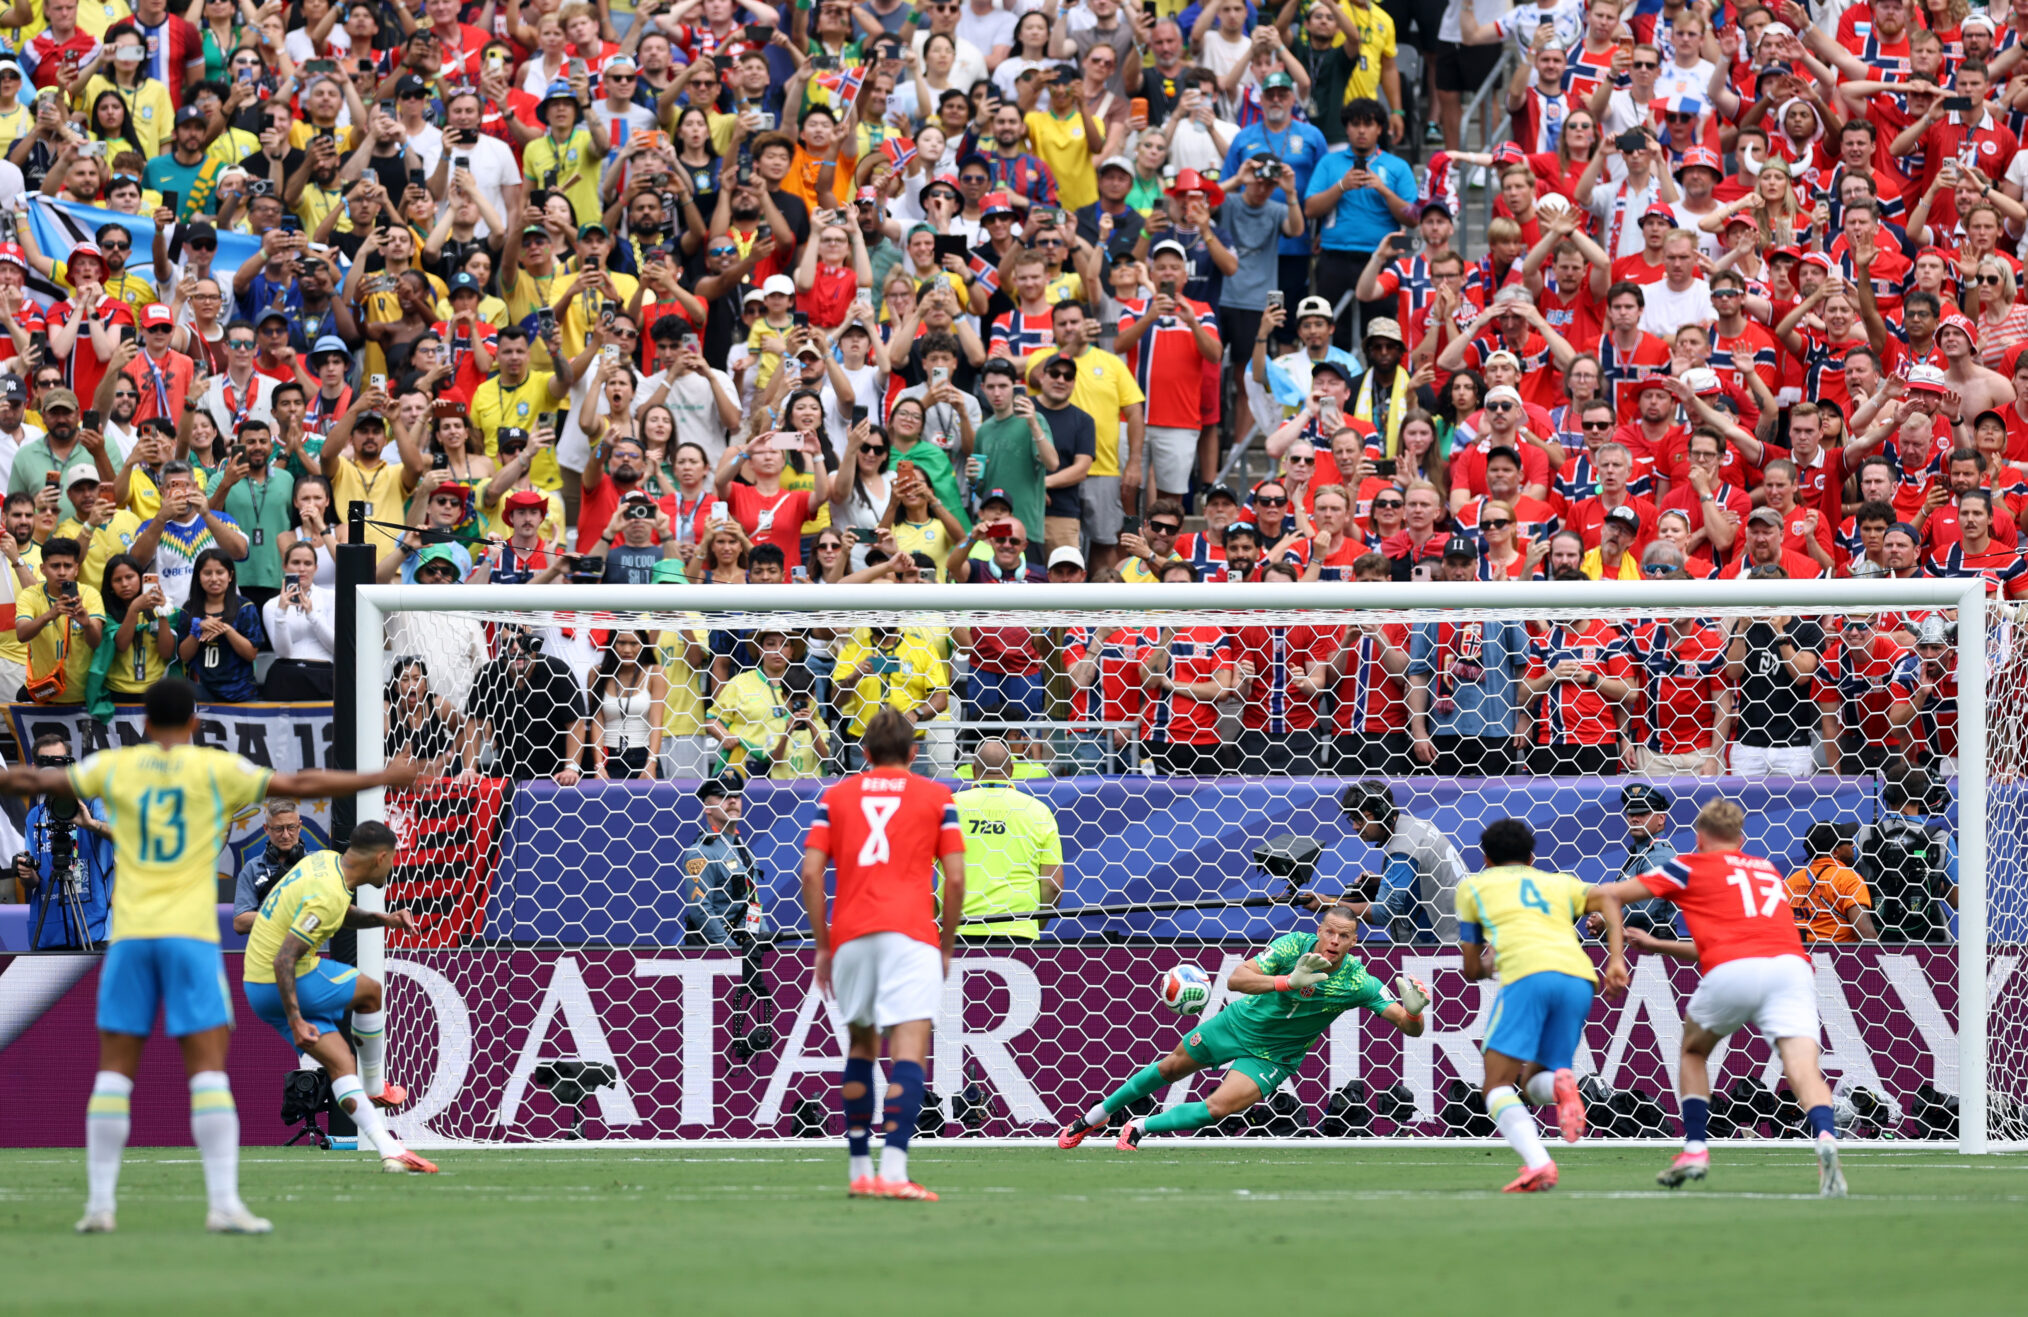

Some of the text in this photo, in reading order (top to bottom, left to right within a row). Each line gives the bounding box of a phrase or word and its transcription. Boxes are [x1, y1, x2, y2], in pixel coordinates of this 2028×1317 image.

[204, 646, 220, 668] 10
[790, 755, 804, 772] 10
[861, 777, 907, 792] BERGE
[138, 786, 186, 862] 13
[857, 796, 902, 867] 8
[261, 867, 303, 920] 8
[1519, 878, 1552, 915] 4
[1726, 868, 1788, 918] 17
